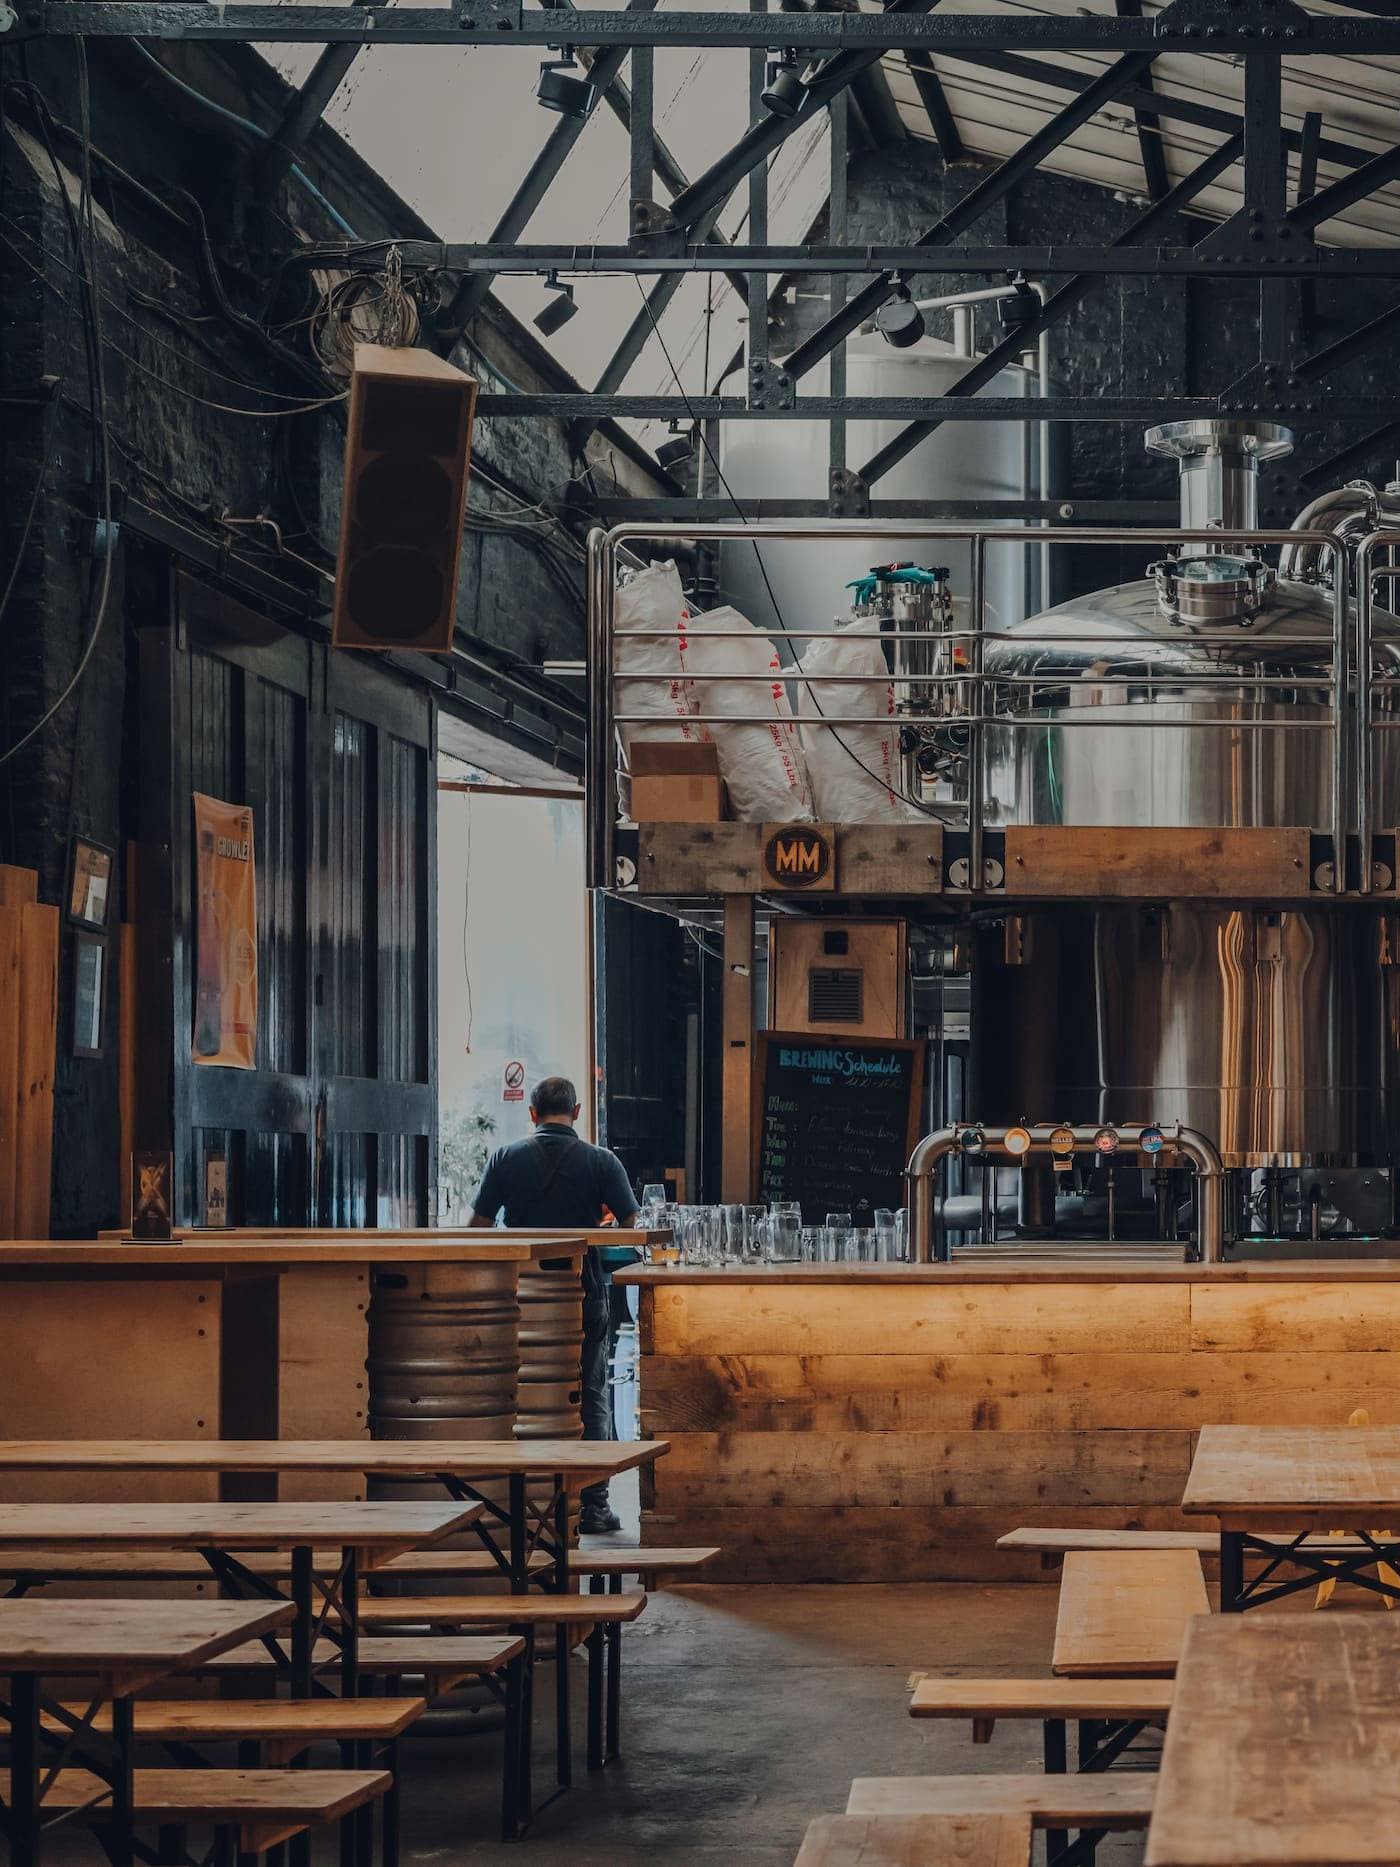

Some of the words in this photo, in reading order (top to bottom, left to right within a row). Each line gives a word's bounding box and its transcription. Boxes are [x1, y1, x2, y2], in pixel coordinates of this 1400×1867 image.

[776, 840, 820, 873] MM
[779, 1049, 843, 1070] BREWING
[842, 1051, 902, 1076] Schedule
